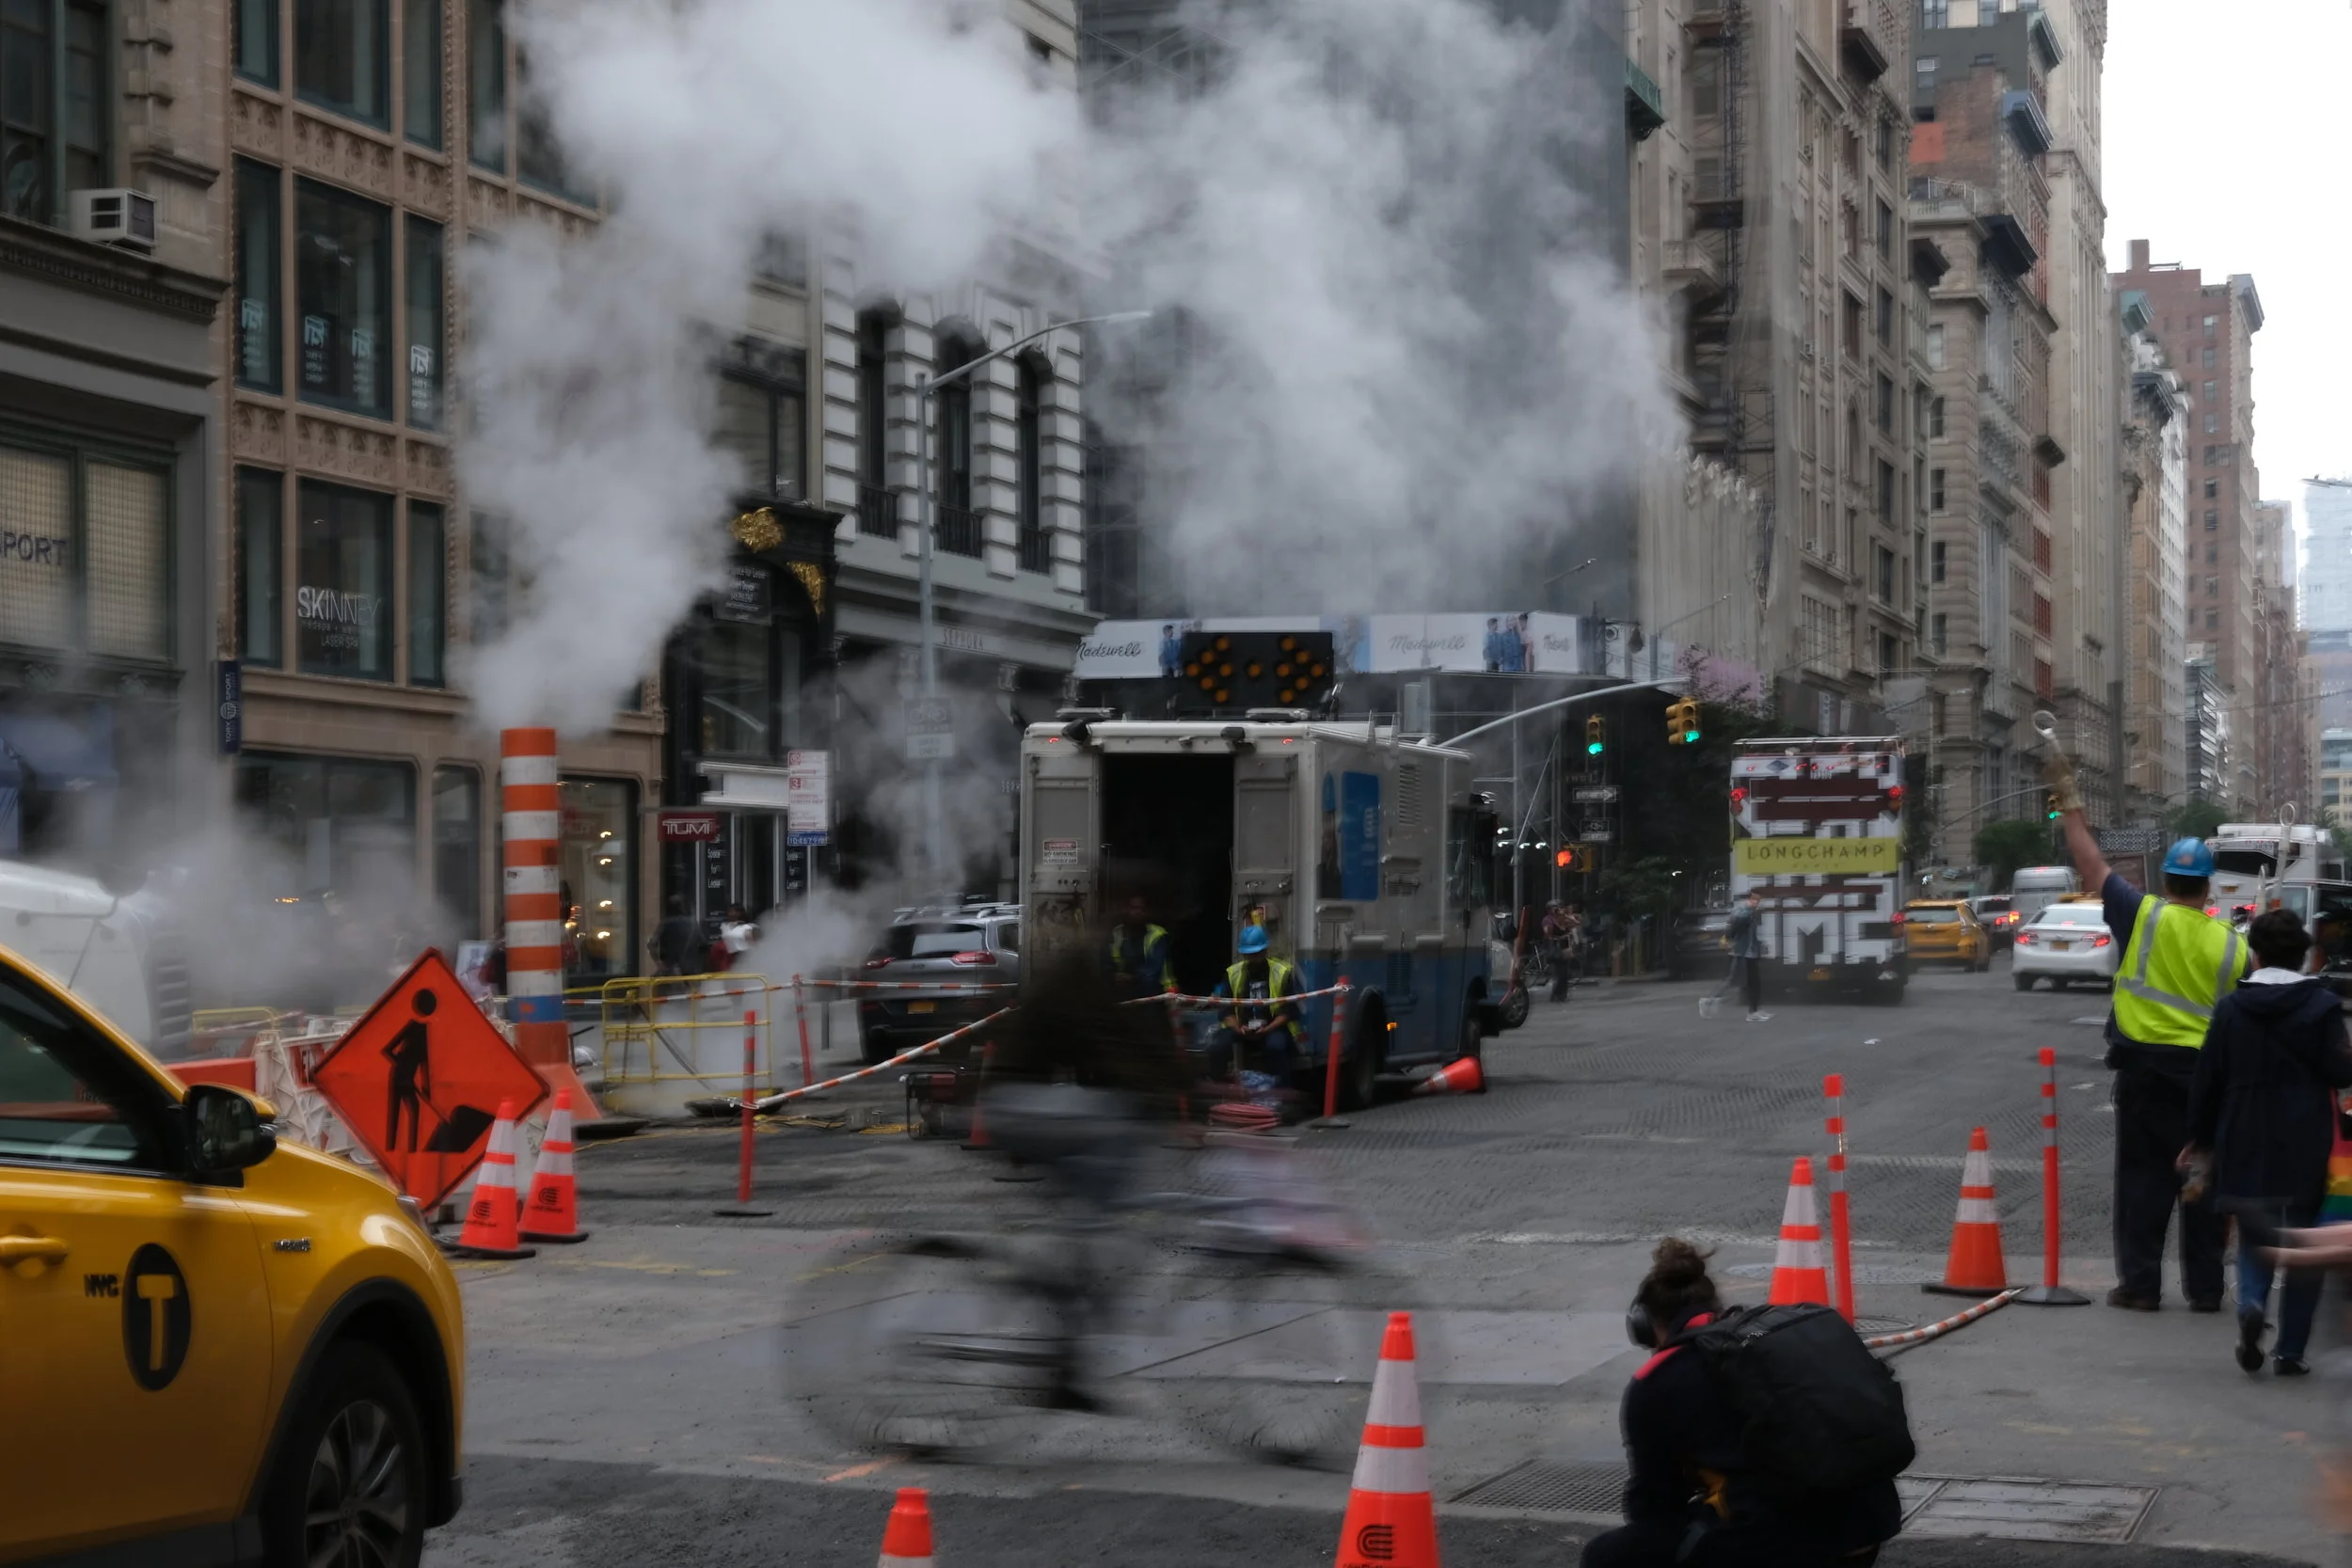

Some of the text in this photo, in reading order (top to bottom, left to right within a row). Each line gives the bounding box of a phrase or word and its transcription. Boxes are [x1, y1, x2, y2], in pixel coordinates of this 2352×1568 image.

[0, 531, 69, 565] PORT
[297, 587, 382, 625] SKINNEY
[944, 627, 984, 651] SEPHORA
[662, 818, 715, 835] TUMI
[1747, 845, 1883, 861] LONGCHAMP
[84, 1274, 119, 1297] NYC
